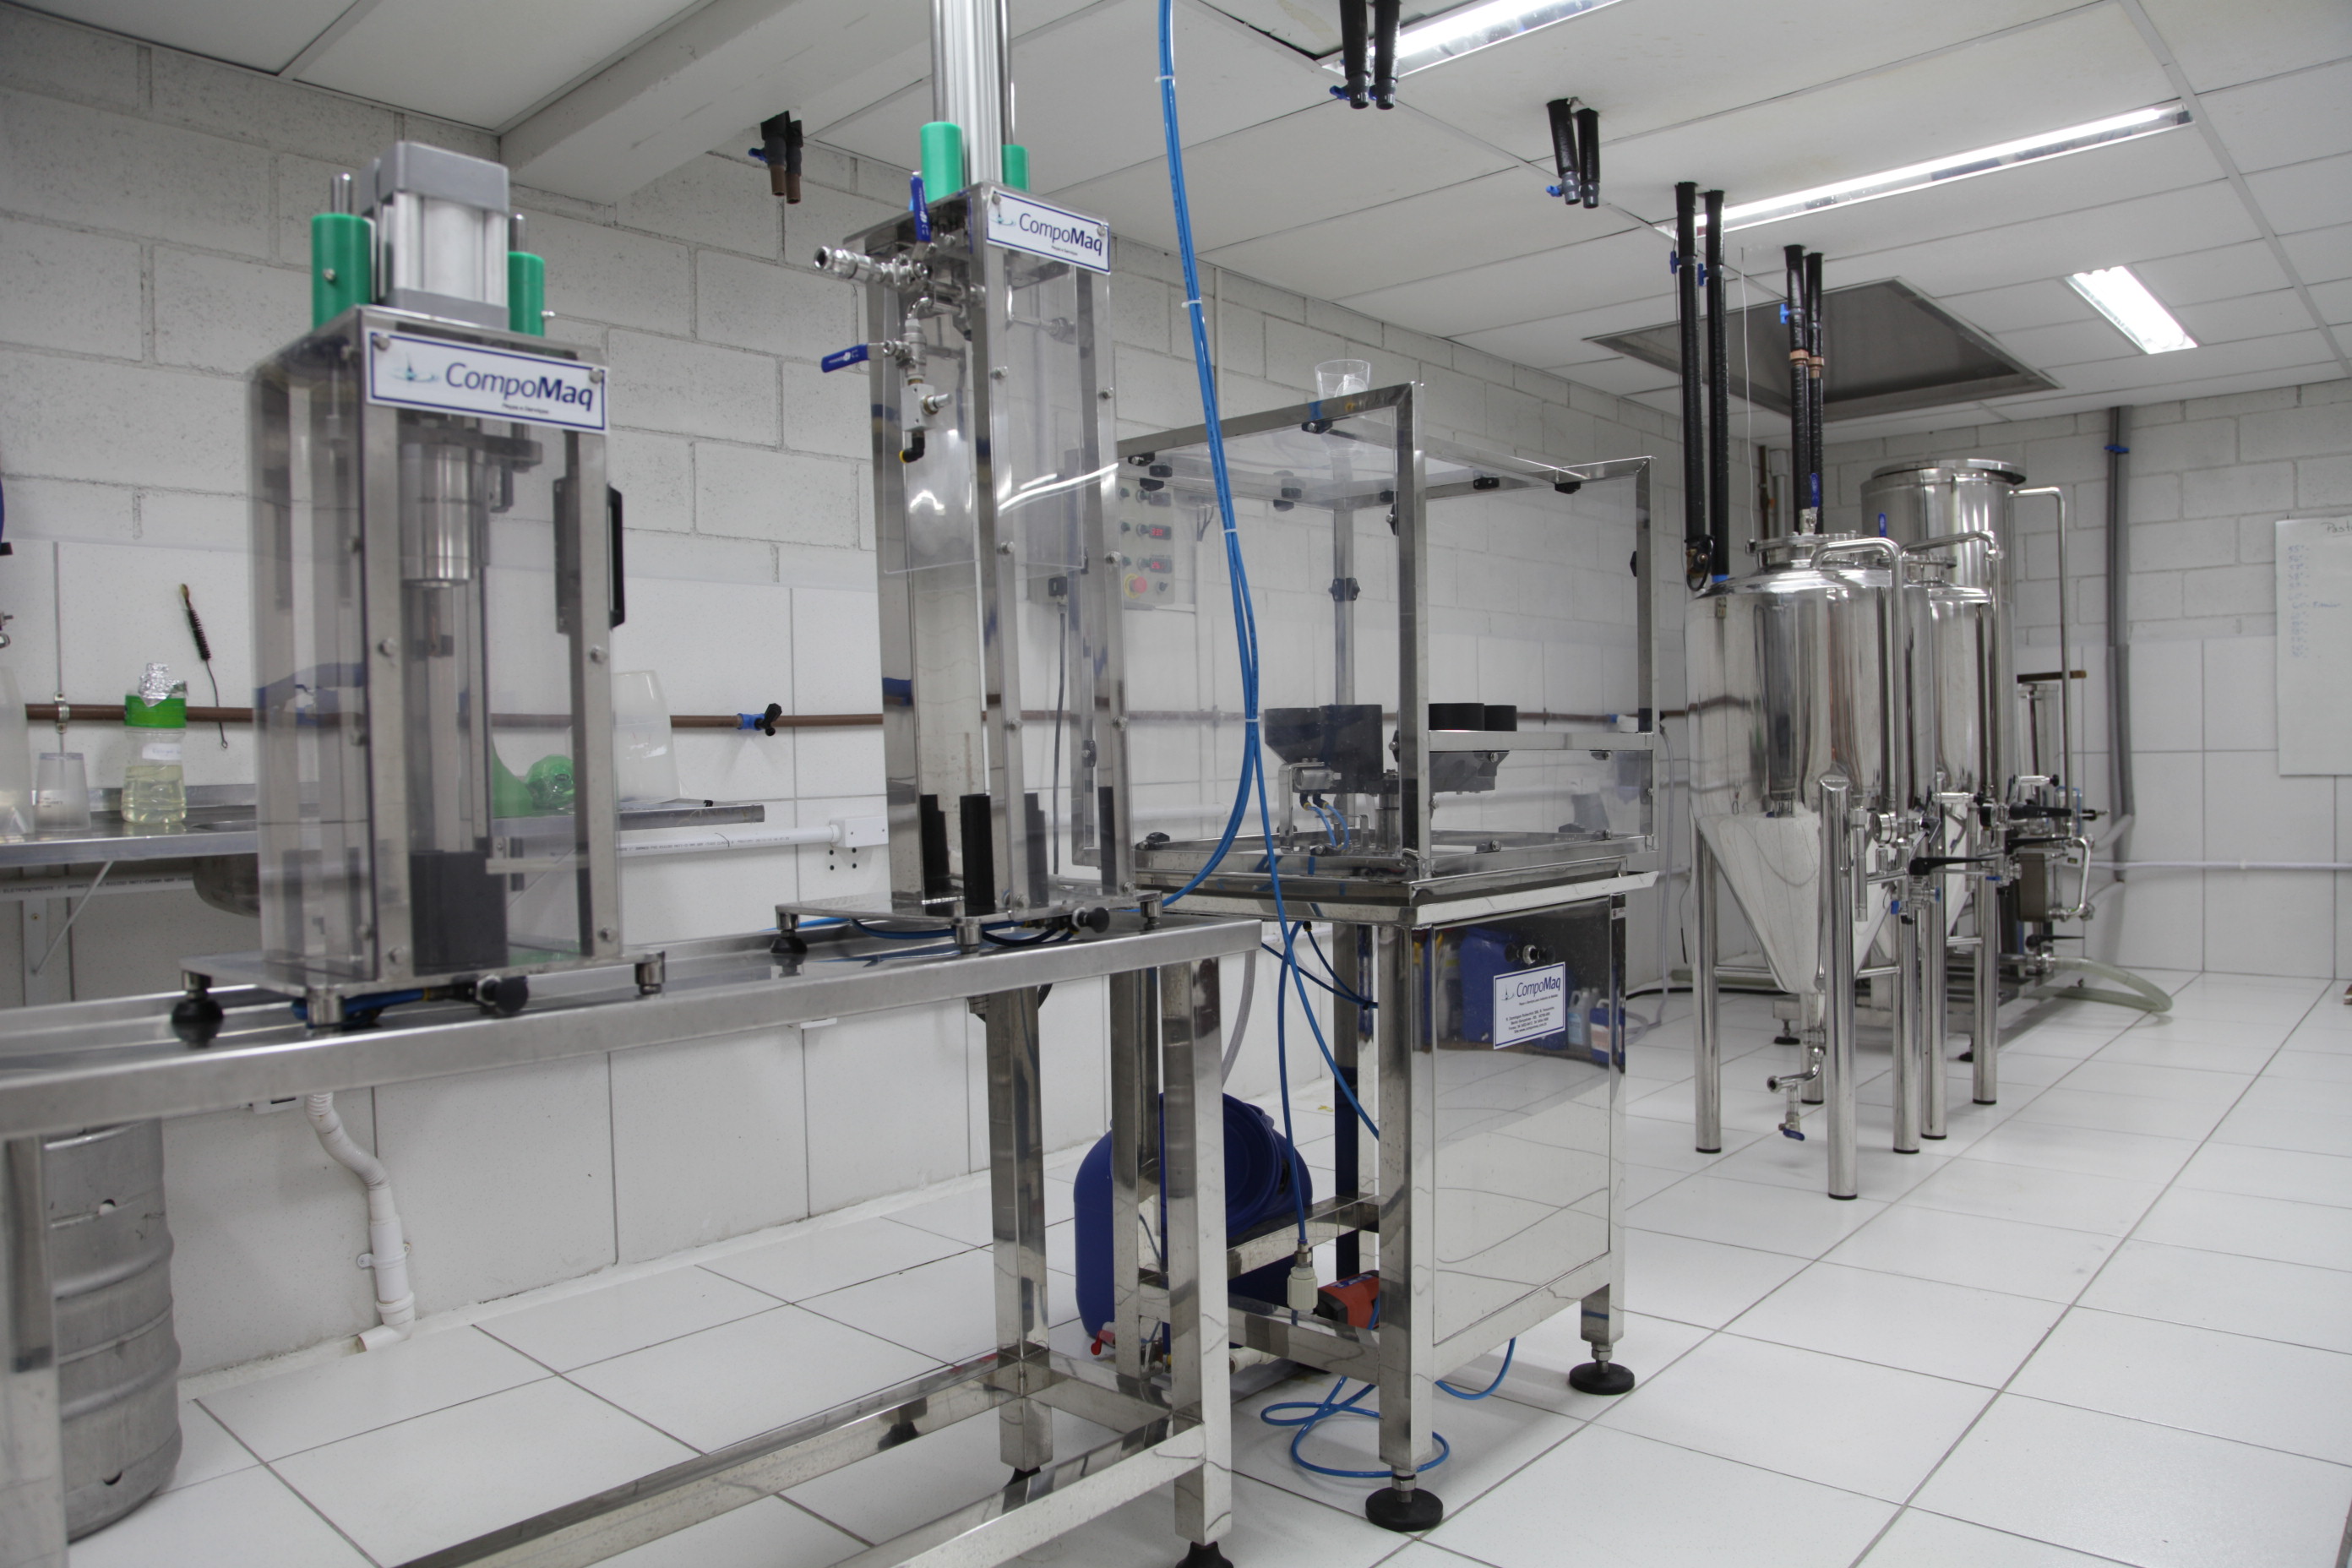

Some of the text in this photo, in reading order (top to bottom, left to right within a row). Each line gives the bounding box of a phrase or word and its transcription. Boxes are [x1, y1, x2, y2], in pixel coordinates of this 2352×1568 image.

[1019, 213, 1102, 256] CompoMaq
[445, 362, 593, 412] CompoMaq
[1516, 976, 1561, 998] CompoMaq
